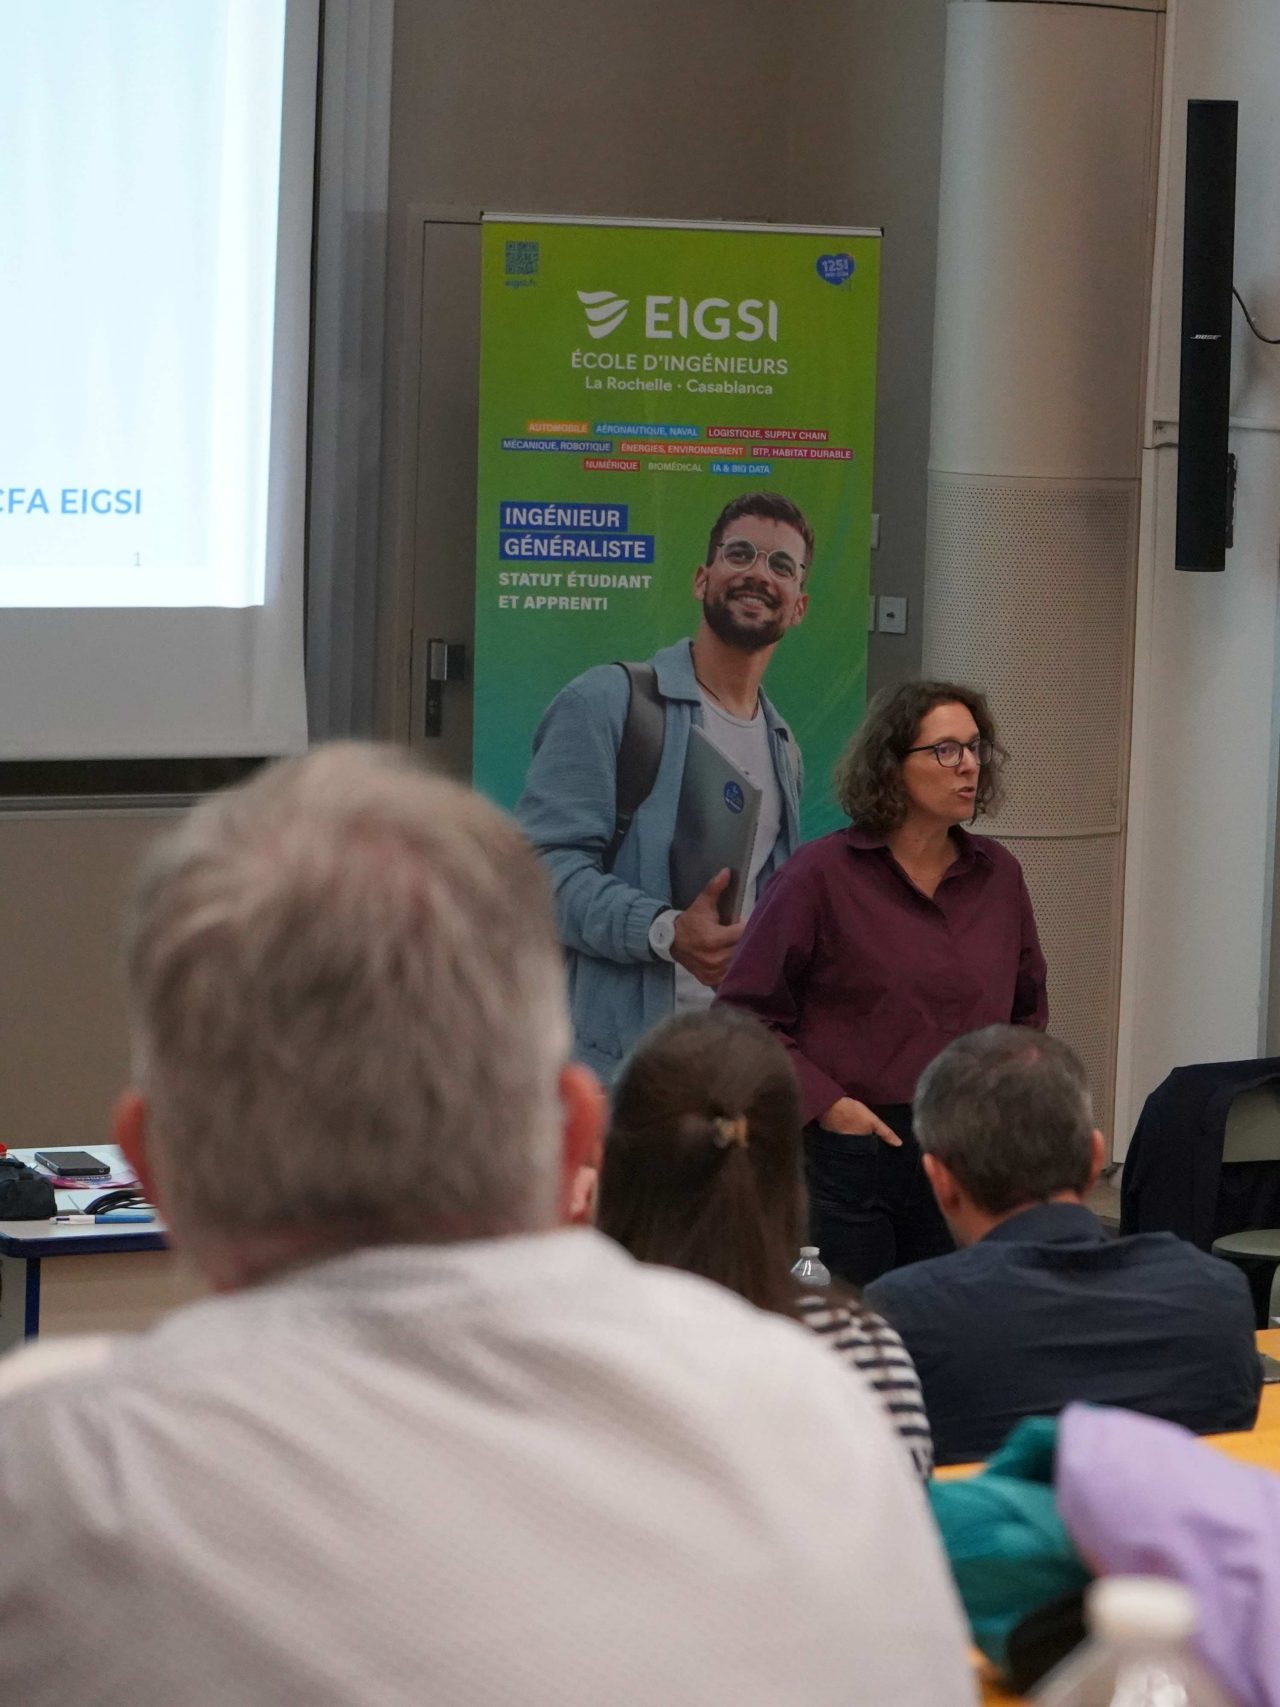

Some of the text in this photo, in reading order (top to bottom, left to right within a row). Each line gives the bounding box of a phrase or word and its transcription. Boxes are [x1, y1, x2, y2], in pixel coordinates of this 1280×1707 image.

[645, 295, 778, 342] EIGSI
[571, 349, 788, 375] ÉCOLE D'INGÉNIEURS
[585, 376, 773, 395] La Rochelle Casablanca
[528, 423, 588, 433] AUTOMOBILE
[670, 427, 698, 437] NAVAL
[708, 428, 827, 440] LOGISTIQUE, SUPPLY CHAIN
[503, 439, 610, 452] MÉCANIQUE, ROBOTIQUE
[621, 442, 743, 455] ÉNERGIES, ENVIRONNEMENT
[752, 448, 851, 459] BTP, HABITAT DURABLE
[585, 459, 638, 470] NUMÉRIQUE
[648, 461, 703, 472] BIOMÉDICAL
[713, 464, 770, 474] IA & BIG DATA
[0, 488, 142, 515] FA EIGSI
[505, 504, 620, 528] INGÉNIEUR
[504, 534, 647, 559] GÉNÉRALISTE
[133, 551, 142, 567] 1
[499, 571, 652, 589] STATUT ÉTUDIANT
[498, 595, 608, 611] ET APPRENTI
